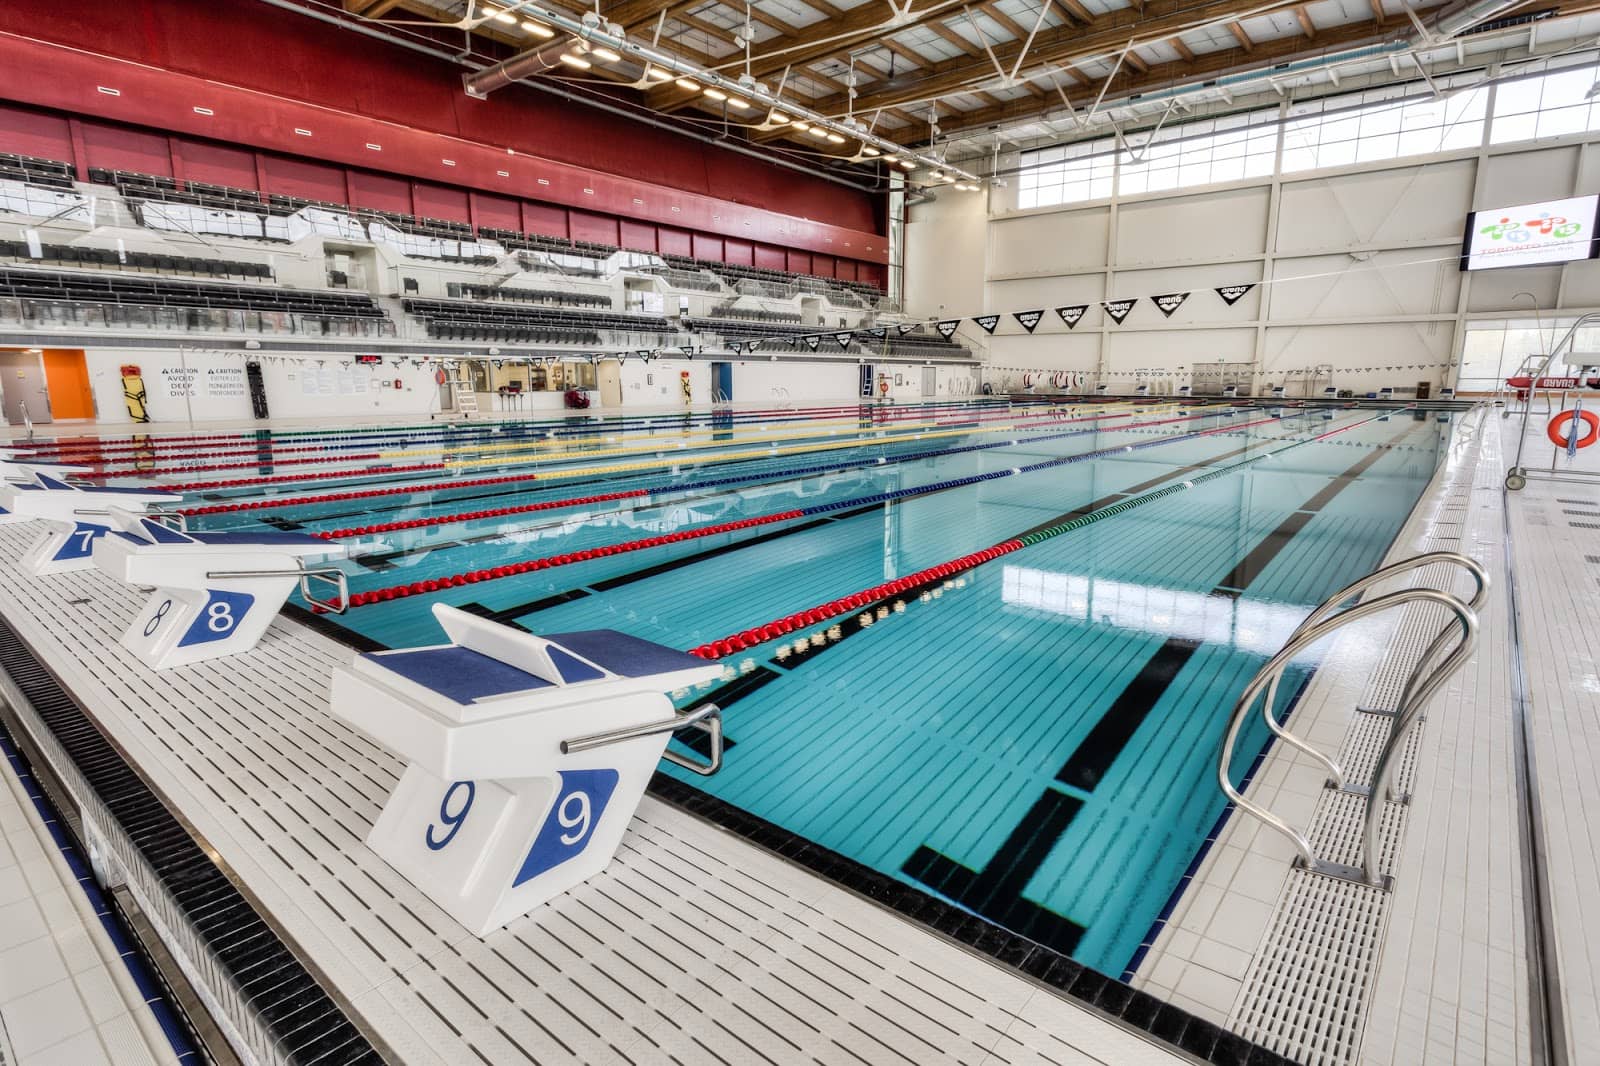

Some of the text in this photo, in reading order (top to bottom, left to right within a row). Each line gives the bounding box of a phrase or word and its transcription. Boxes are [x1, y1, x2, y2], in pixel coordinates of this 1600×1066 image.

[1221, 286, 1248, 294] arena
[1158, 295, 1182, 304] arena
[1109, 302, 1130, 311] arena
[1020, 313, 1039, 321] arena
[1062, 308, 1083, 317] arena
[1543, 379, 1575, 387] GUARD
[75, 530, 95, 551] 7
[143, 599, 172, 637] 8
[208, 601, 234, 632] 8
[425, 780, 476, 851] 9
[558, 790, 592, 845] 9
